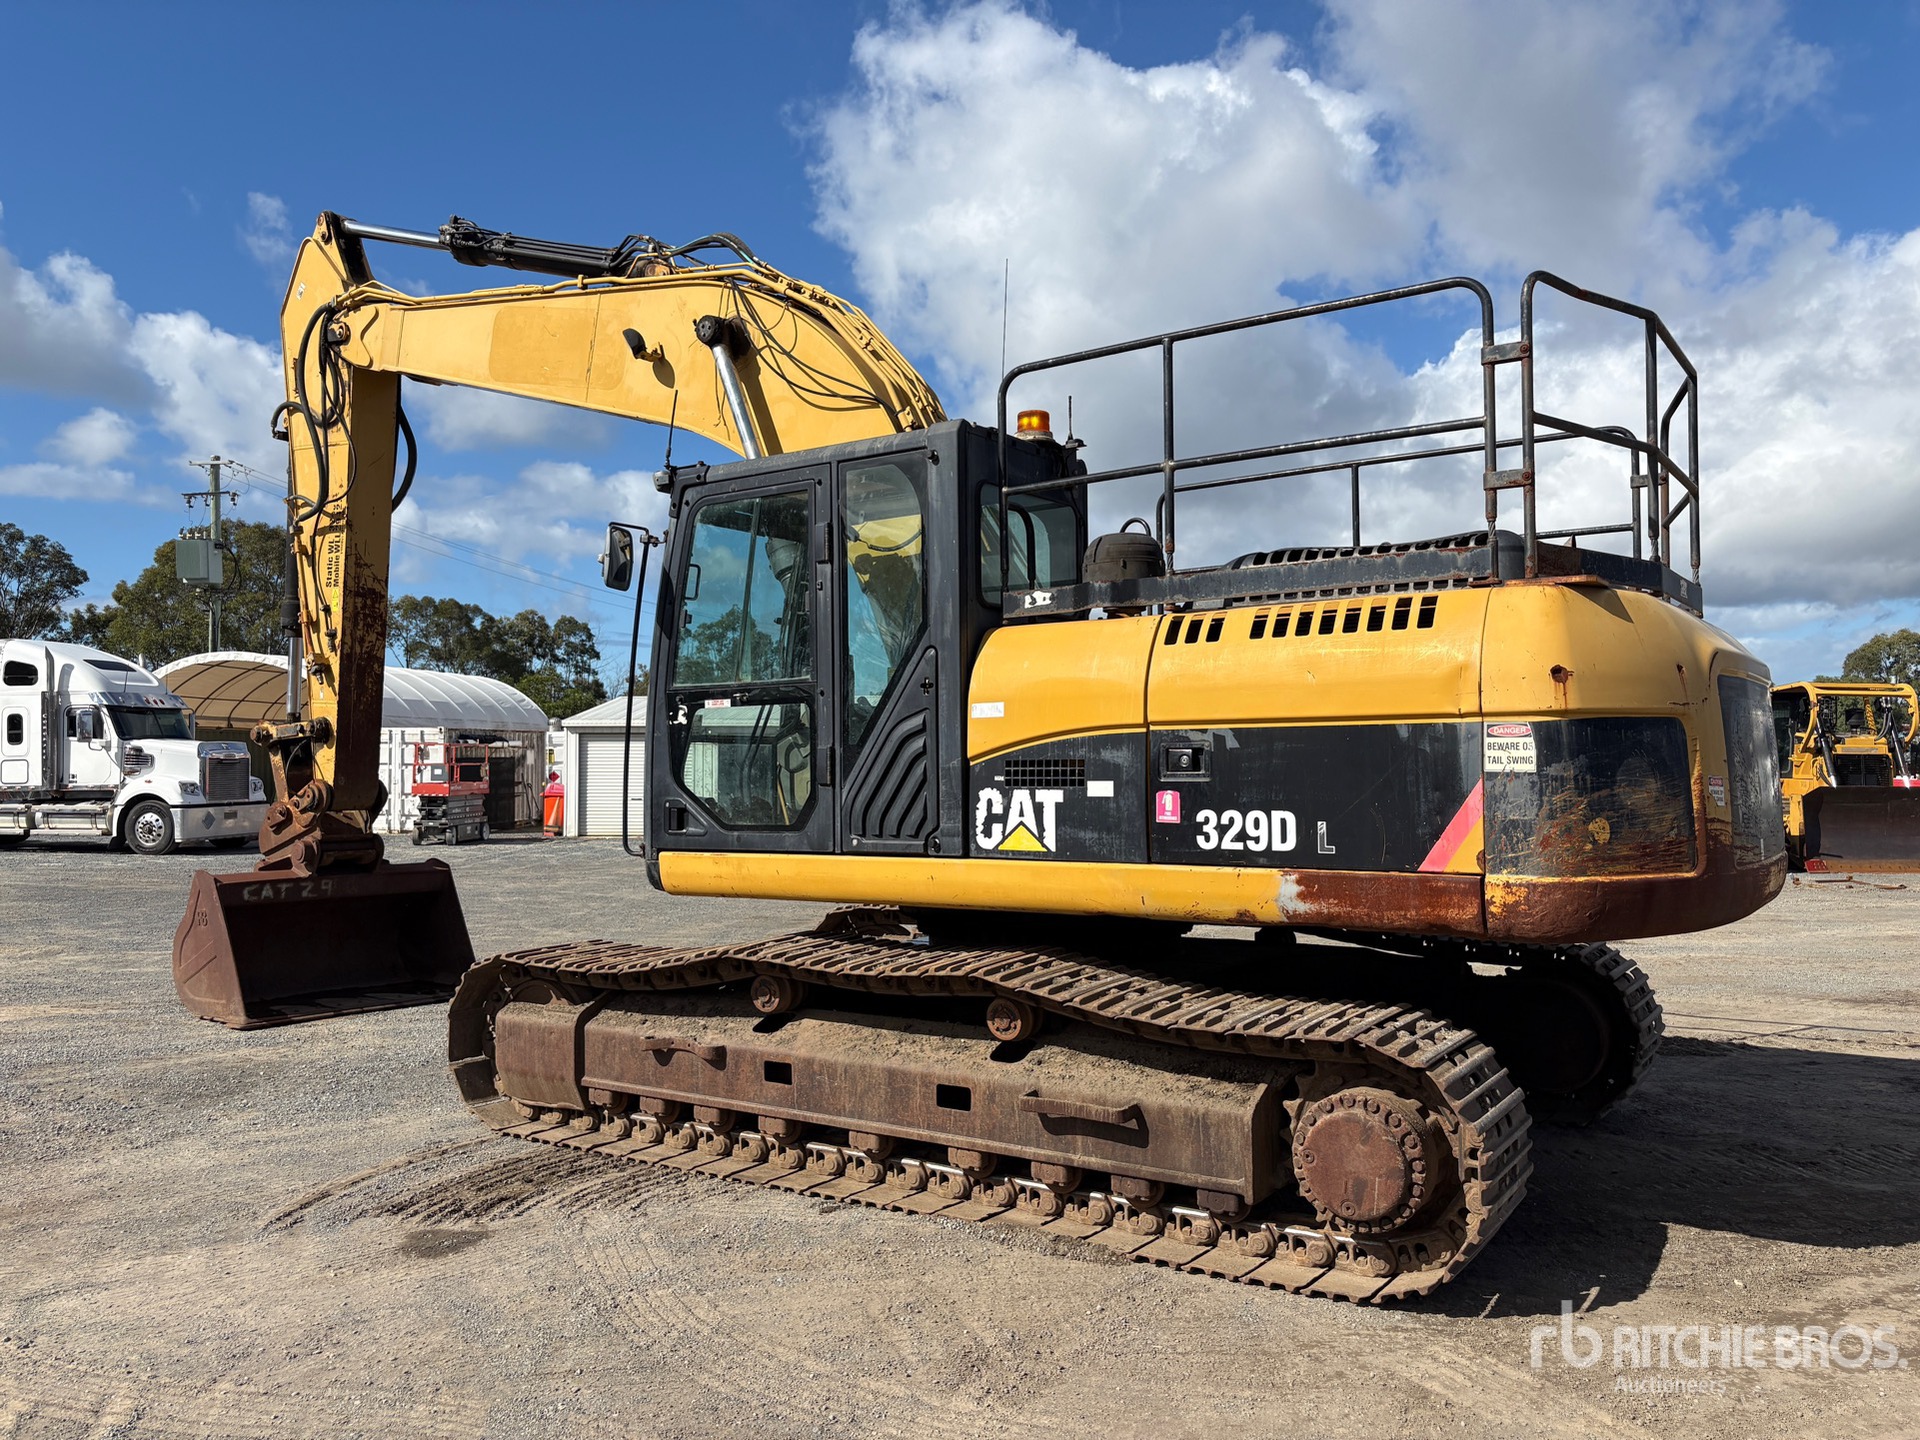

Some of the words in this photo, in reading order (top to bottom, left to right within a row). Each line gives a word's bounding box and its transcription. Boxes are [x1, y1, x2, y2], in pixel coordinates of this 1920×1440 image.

[326, 555, 334, 588] Static
[1487, 742, 1520, 750] BEWARE
[1487, 756, 1504, 764] TAIL
[1506, 756, 1534, 764] SWING
[976, 787, 1064, 852] CAT
[1196, 809, 1297, 852] 329D
[1317, 821, 1336, 854] L
[242, 882, 294, 900] CAT
